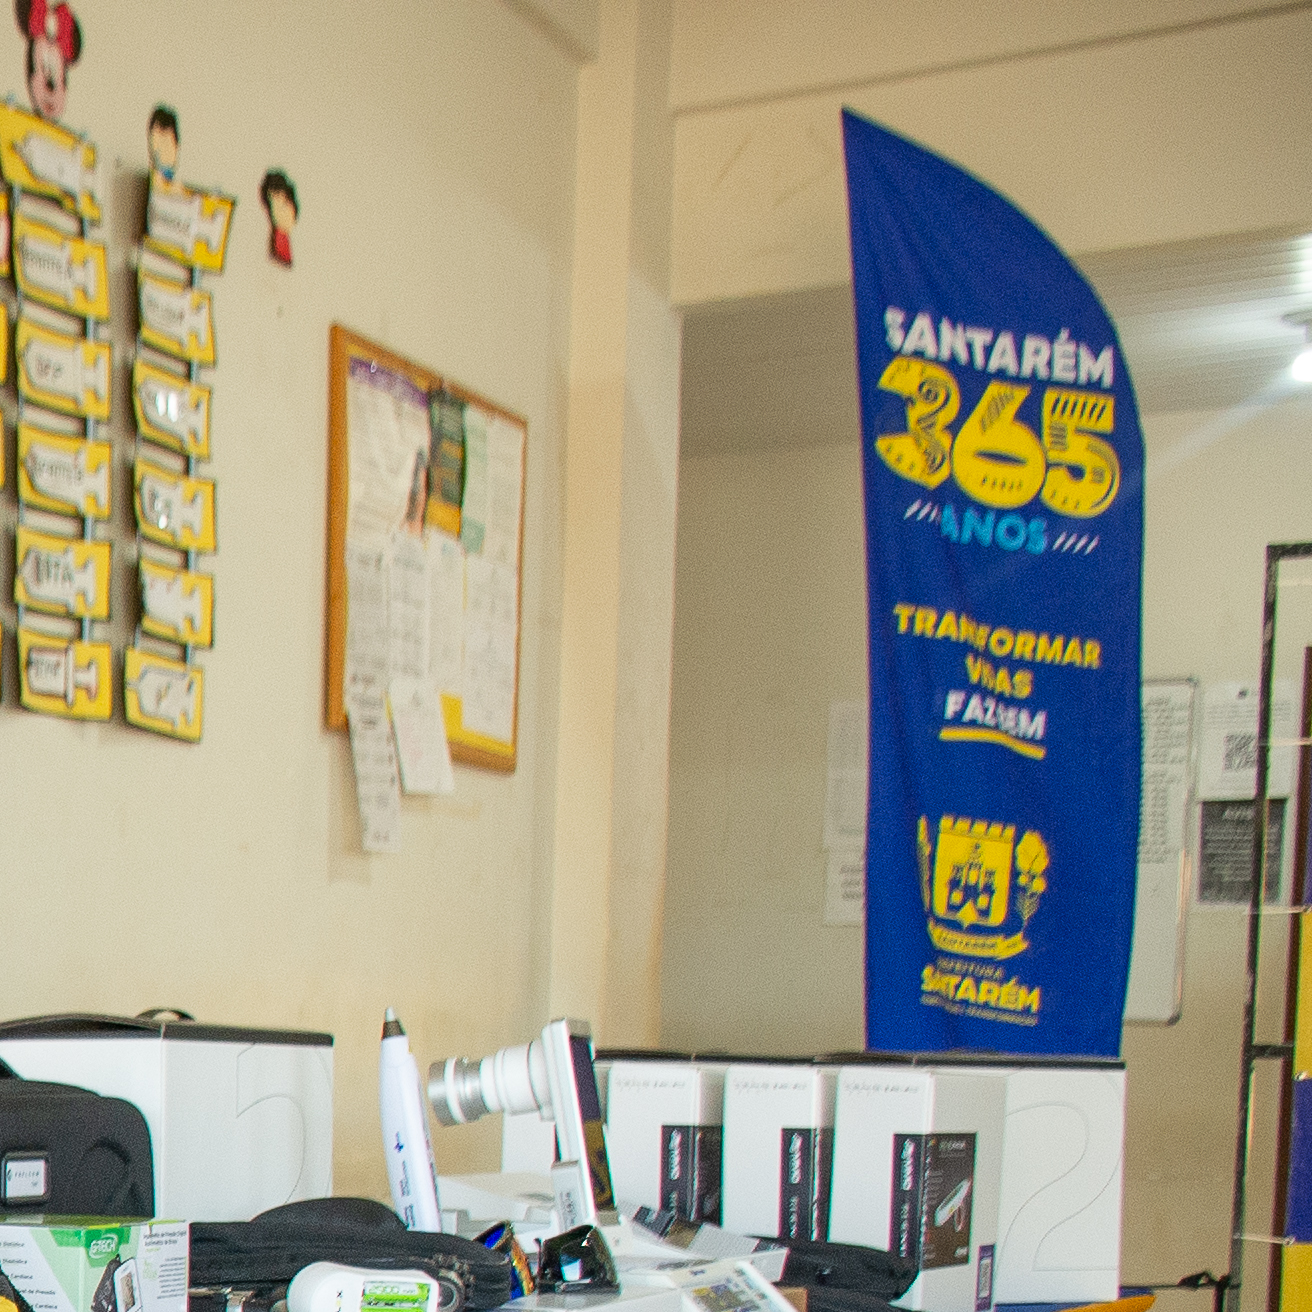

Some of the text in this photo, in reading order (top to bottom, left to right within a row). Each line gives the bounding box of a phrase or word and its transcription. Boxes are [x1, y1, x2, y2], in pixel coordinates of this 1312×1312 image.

[883, 304, 1114, 389] SANTARÉM
[876, 355, 1120, 518] 365
[941, 504, 1047, 554] ANOS
